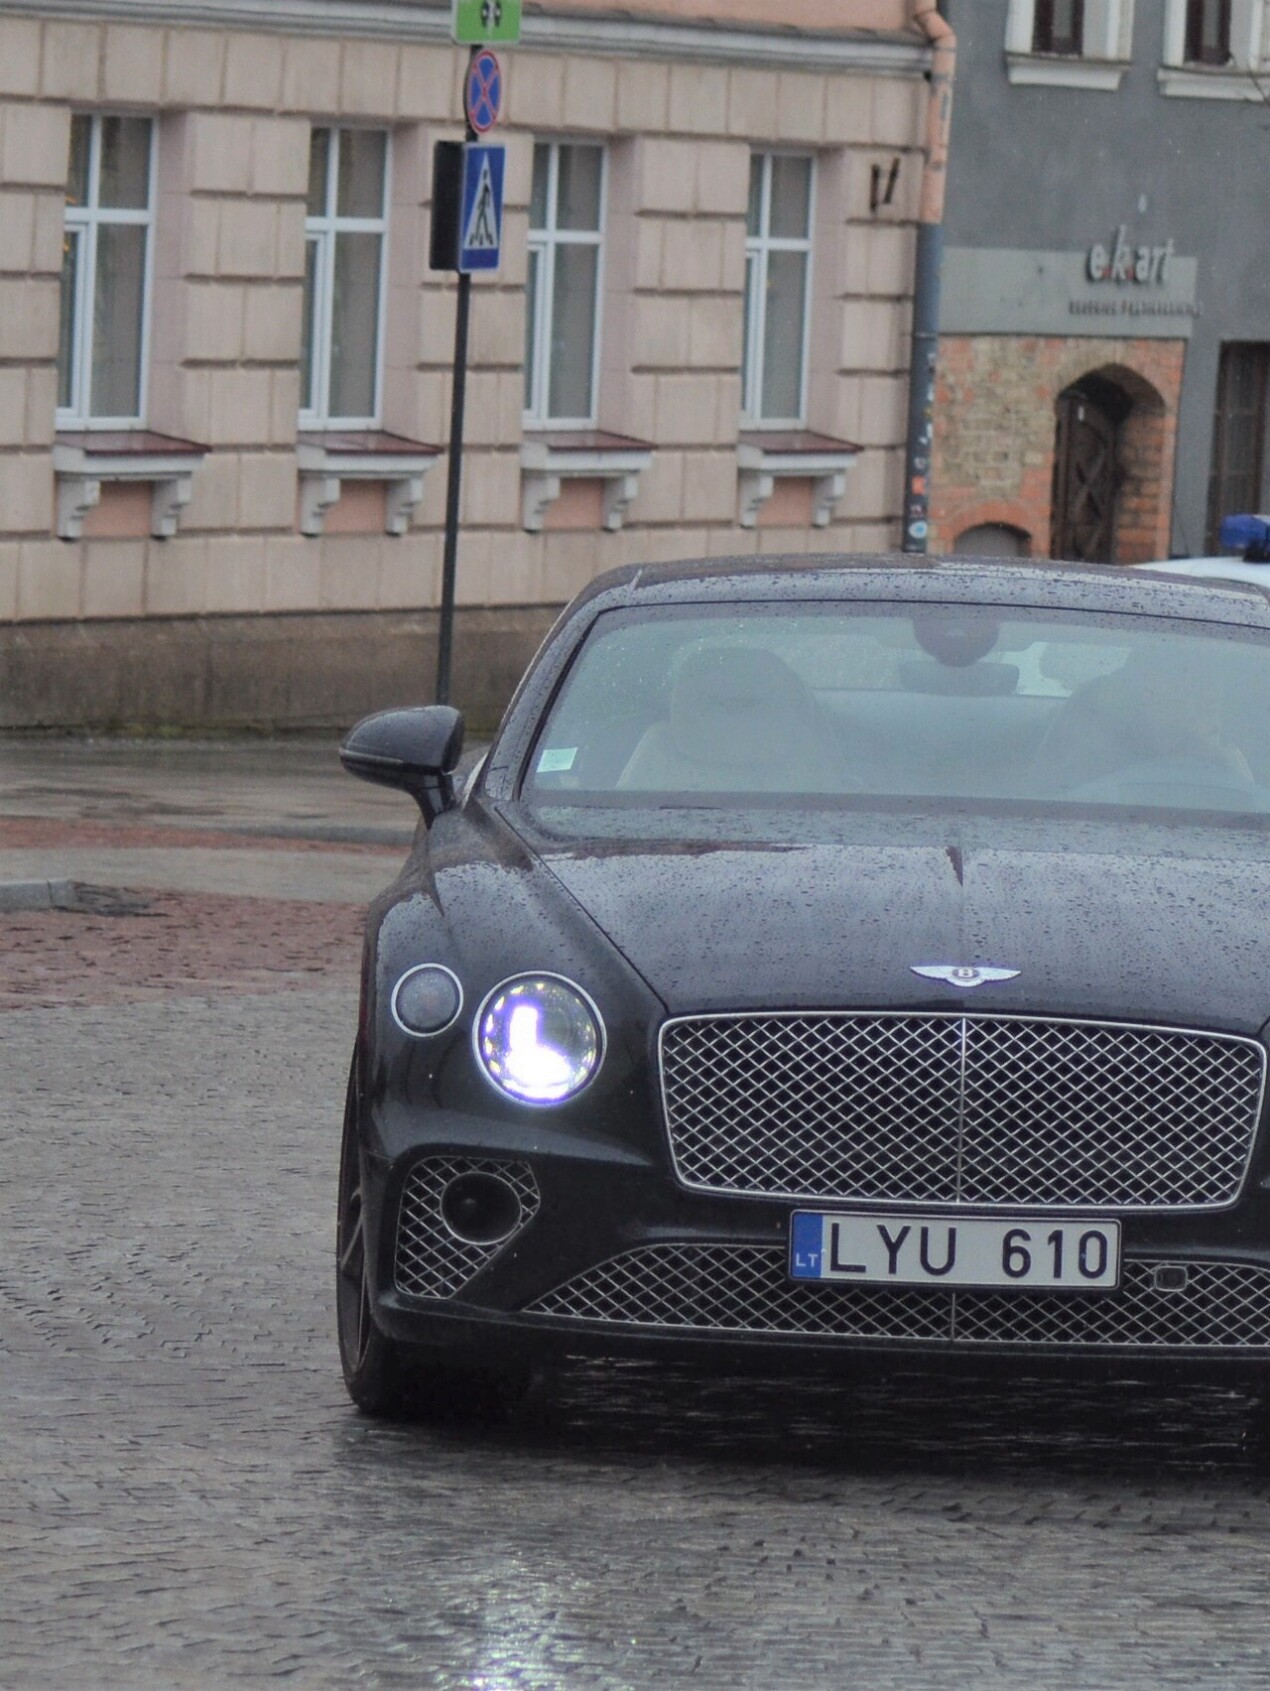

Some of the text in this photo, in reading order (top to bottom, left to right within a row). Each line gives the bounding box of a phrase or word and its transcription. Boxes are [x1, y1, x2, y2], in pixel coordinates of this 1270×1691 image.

[795, 1253, 818, 1269] LT
[830, 1222, 1108, 1279] LYU 610
